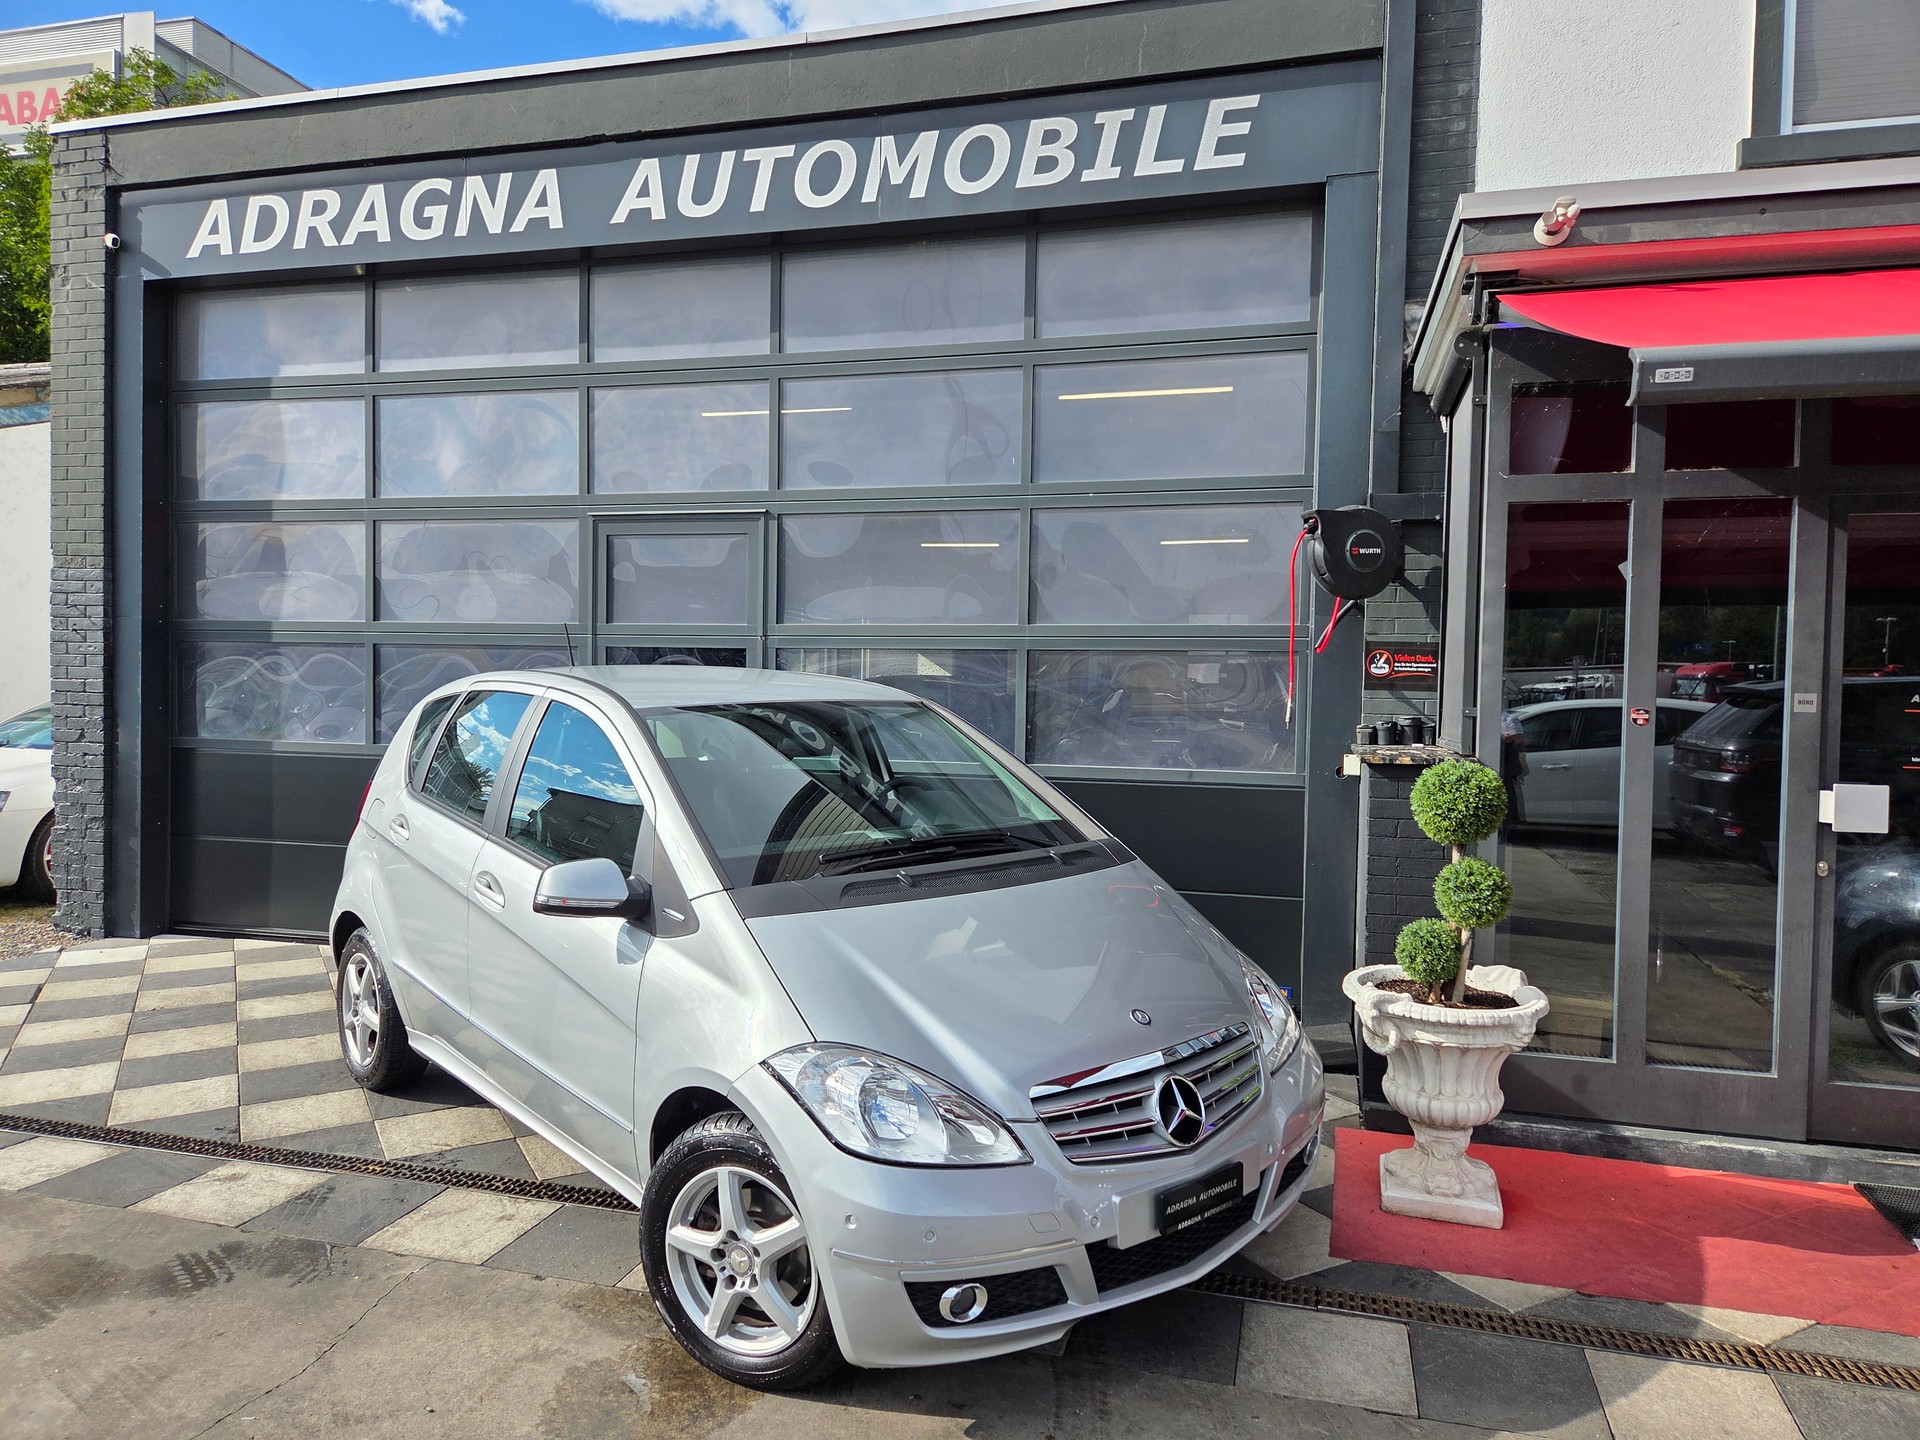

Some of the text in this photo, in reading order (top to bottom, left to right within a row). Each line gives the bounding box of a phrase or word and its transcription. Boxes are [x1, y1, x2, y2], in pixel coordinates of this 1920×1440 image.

[0, 86, 87, 125] ABA
[186, 94, 1262, 259] ADRAGNA AUTOMOBILE
[1395, 654, 1415, 662] Vielen
[1166, 1178, 1237, 1215] ADRAGNA AUTOMOBILE
[1177, 1214, 1202, 1230] ADRAGNA
